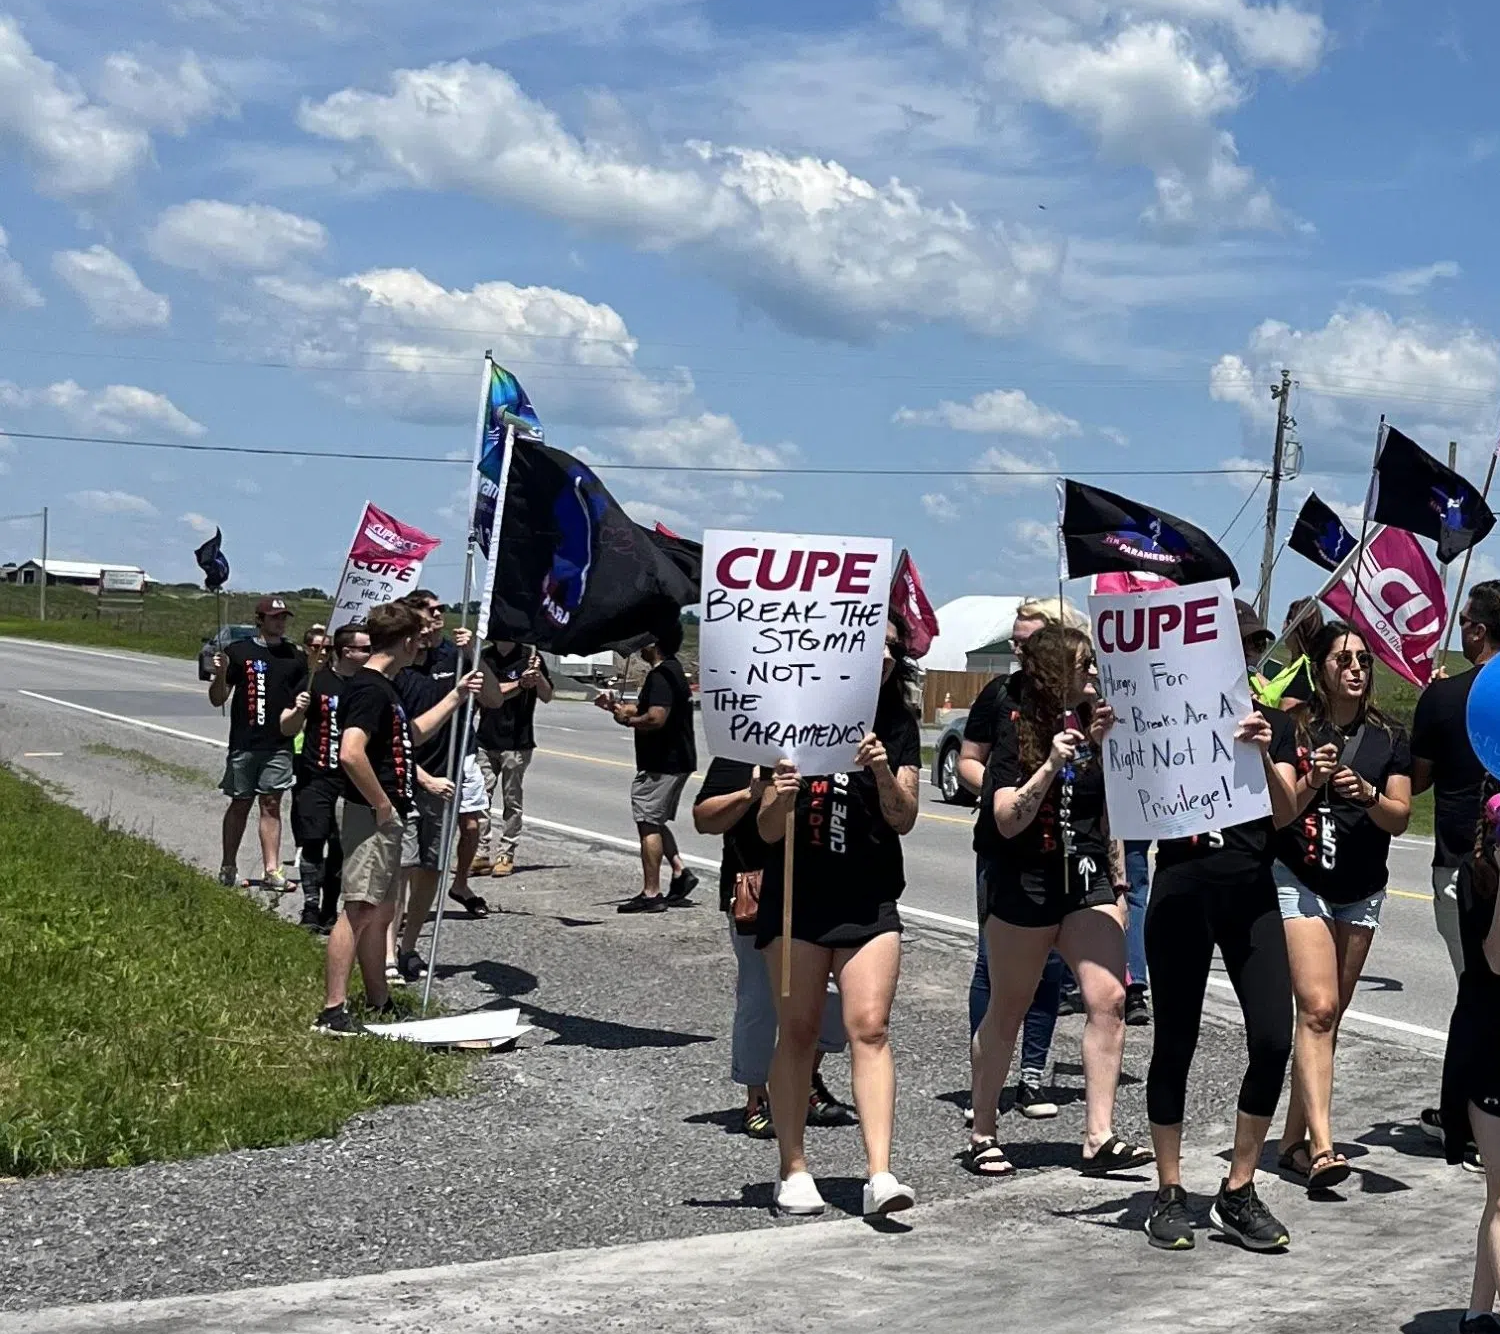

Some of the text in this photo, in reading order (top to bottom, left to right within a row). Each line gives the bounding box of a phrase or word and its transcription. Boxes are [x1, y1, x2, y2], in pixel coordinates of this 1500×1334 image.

[345, 571, 394, 593] FIRST TO
[715, 547, 879, 594] CUPE
[336, 598, 363, 612] LAST
[361, 589, 391, 603] HELP
[704, 588, 883, 627] BREAK THE
[1097, 597, 1219, 654] CUPE
[1150, 662, 1189, 691] For
[703, 688, 762, 711] THE
[1131, 705, 1178, 734] Breaks
[1184, 701, 1208, 725] Are
[1219, 691, 1235, 718] A
[729, 714, 866, 748] PARAMEDICS
[1108, 730, 1233, 780] Right Not A
[1137, 775, 1233, 822] Privilege!
[830, 801, 848, 854] CUPE
[1321, 815, 1337, 870] CUPE
